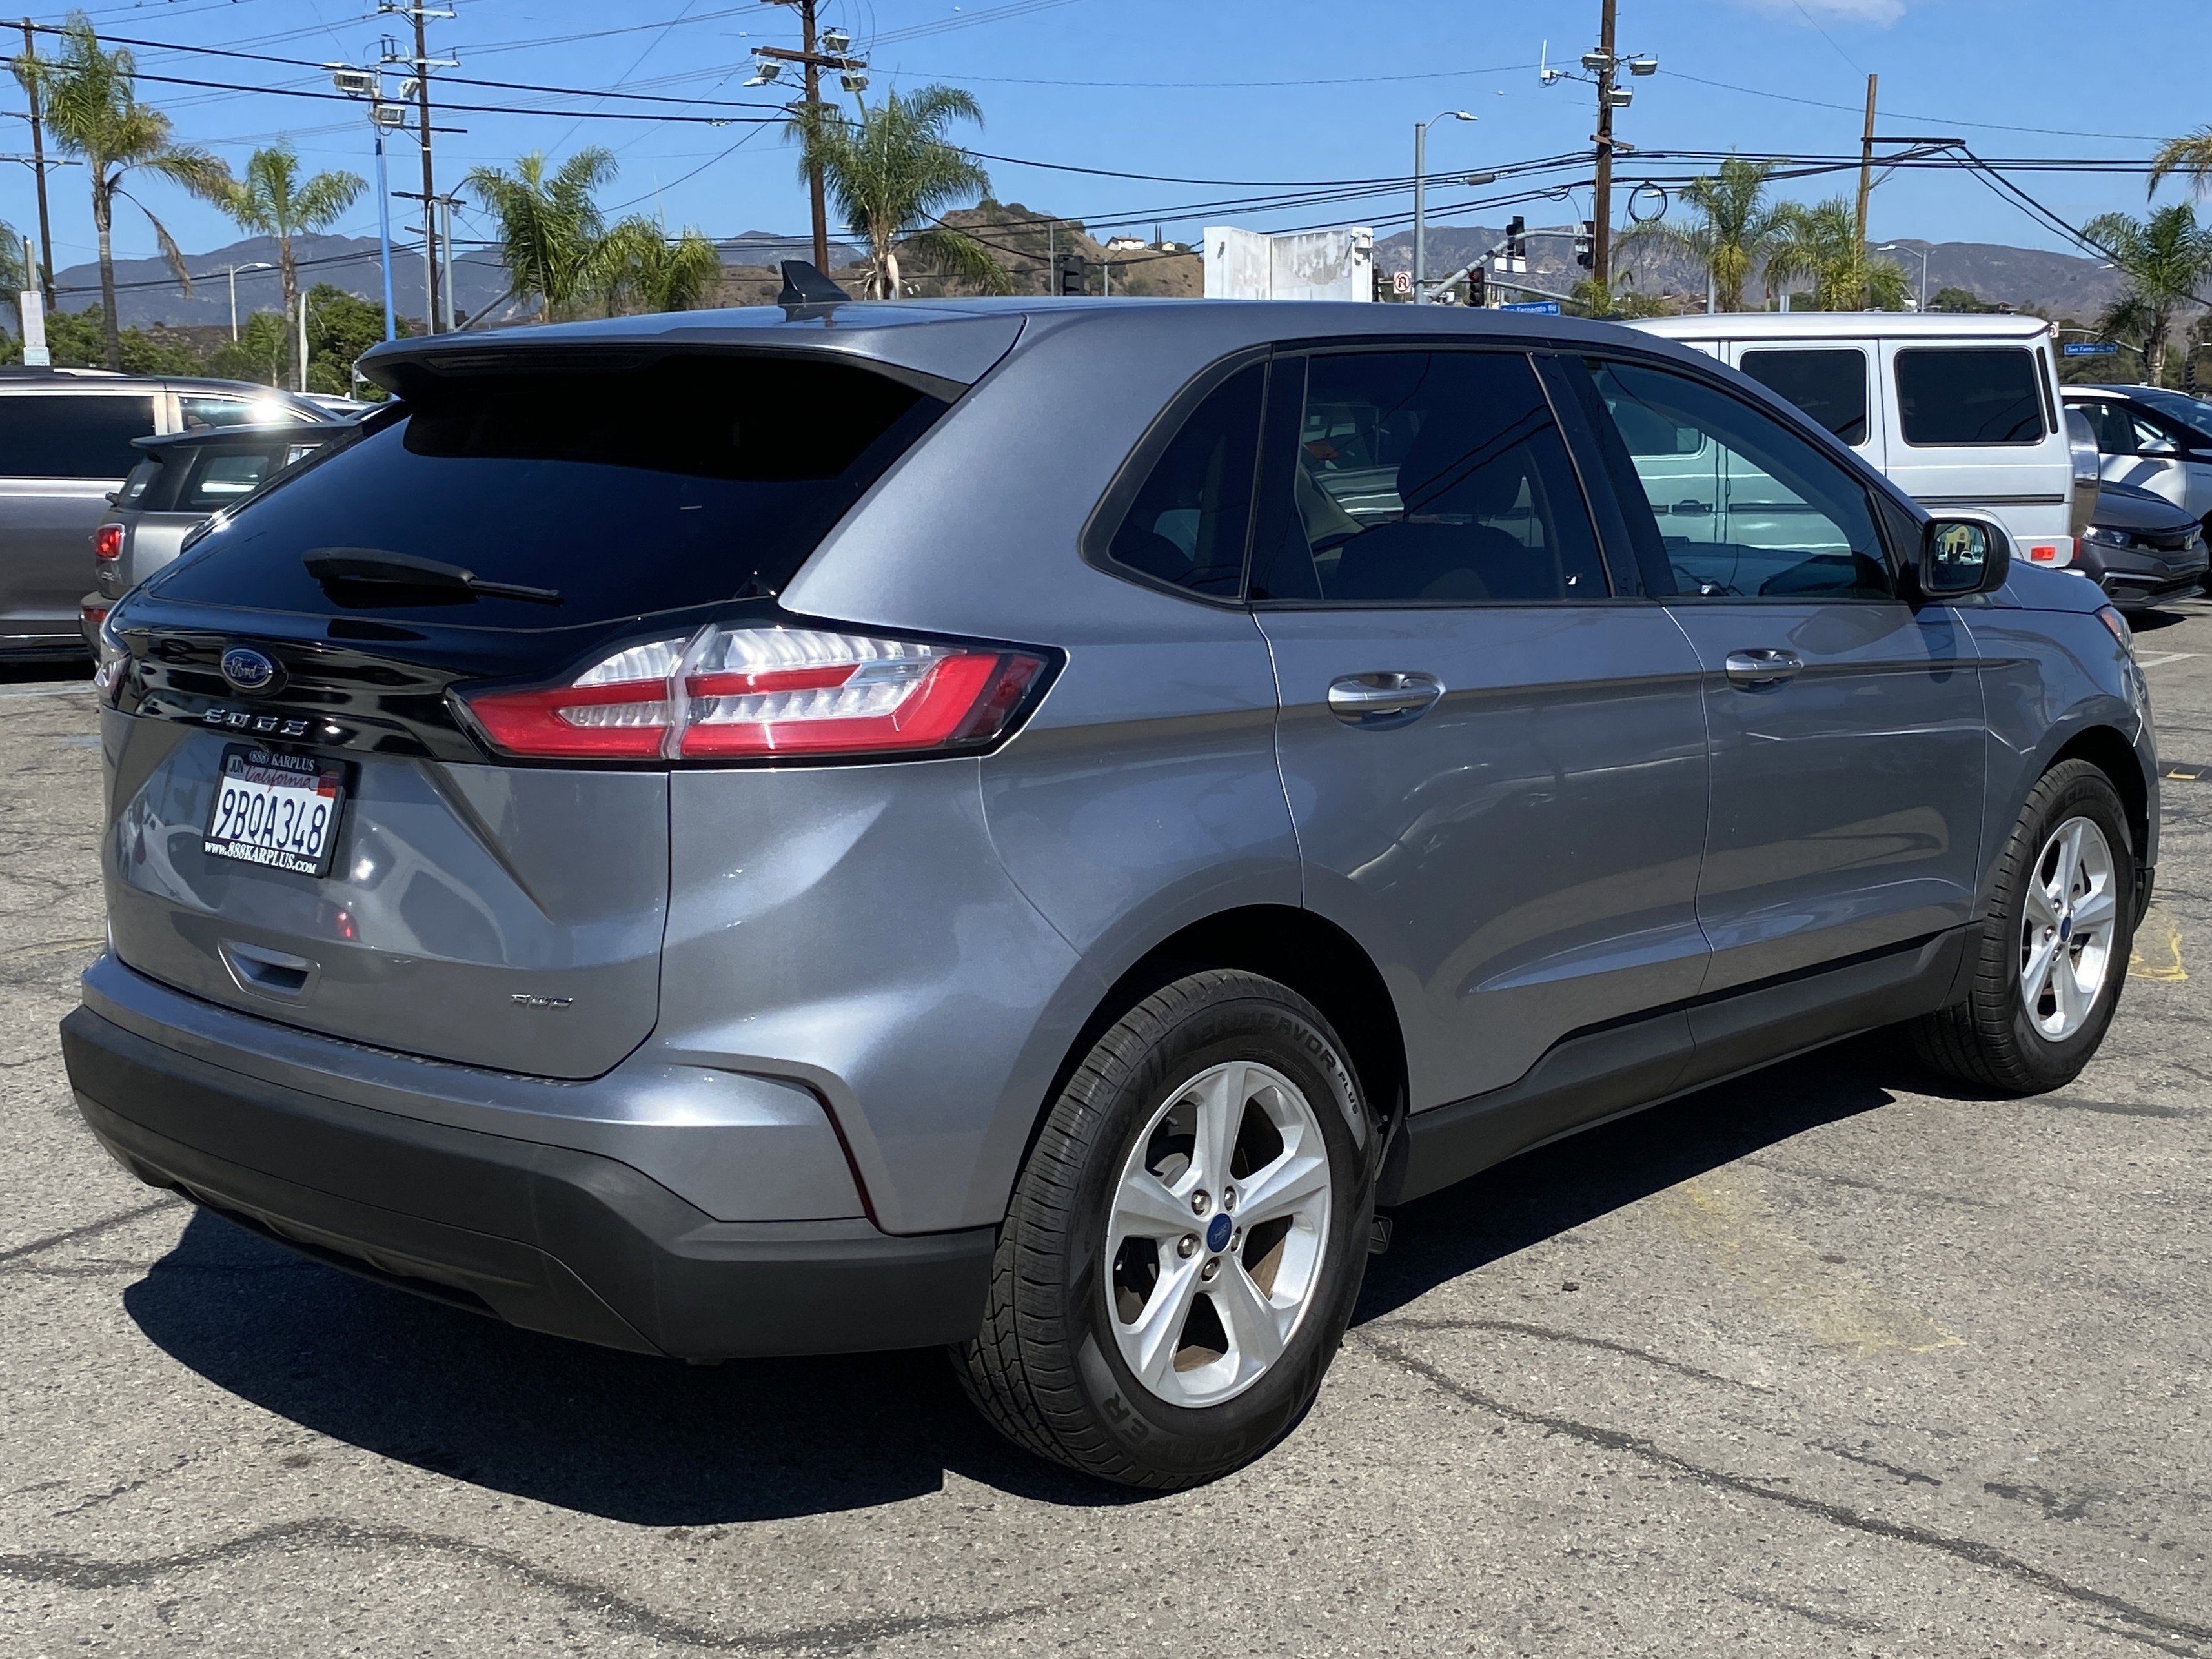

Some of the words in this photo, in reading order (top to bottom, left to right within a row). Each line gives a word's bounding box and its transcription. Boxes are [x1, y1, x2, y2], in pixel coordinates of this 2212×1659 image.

[230, 656, 260, 680] Ford
[249, 749, 270, 764] (888)
[271, 753, 315, 772] KARPLUS
[244, 766, 317, 794] California
[215, 788, 327, 855] 9BQA348
